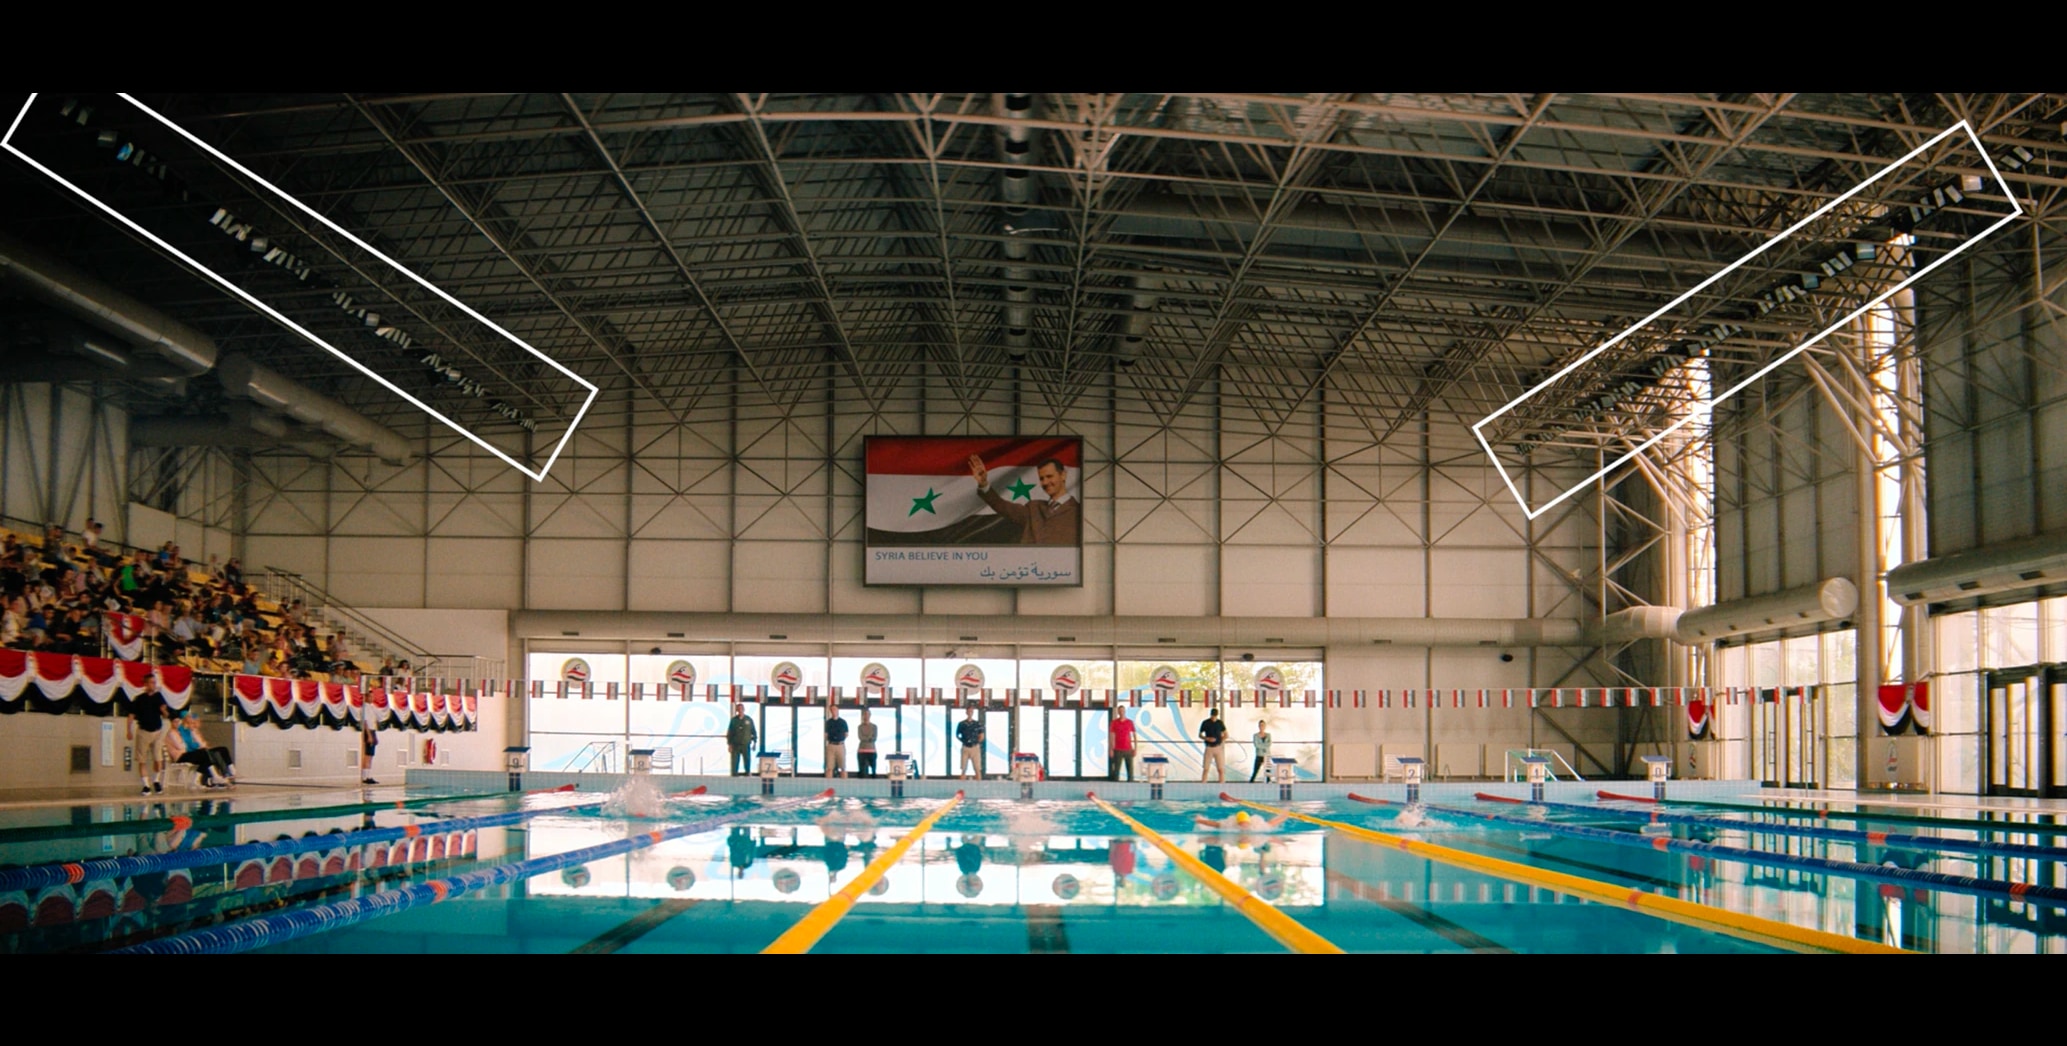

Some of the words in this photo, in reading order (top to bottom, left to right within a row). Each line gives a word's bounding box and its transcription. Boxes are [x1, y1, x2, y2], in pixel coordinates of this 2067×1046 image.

[875, 551, 905, 561] SYRIA
[908, 551, 949, 561] BELIEVE
[952, 551, 963, 561] IN
[965, 551, 988, 561] YOU
[979, 566, 995, 580] بك
[999, 566, 1029, 580] تؤمن
[1030, 562, 1071, 580] سورية
[512, 758, 519, 769] 9
[764, 763, 771, 773] 7
[893, 765, 900, 776] 6
[1024, 767, 1031, 778] 5
[1153, 768, 1160, 779] 4
[1281, 769, 1288, 780] 3
[1408, 769, 1415, 780] 2
